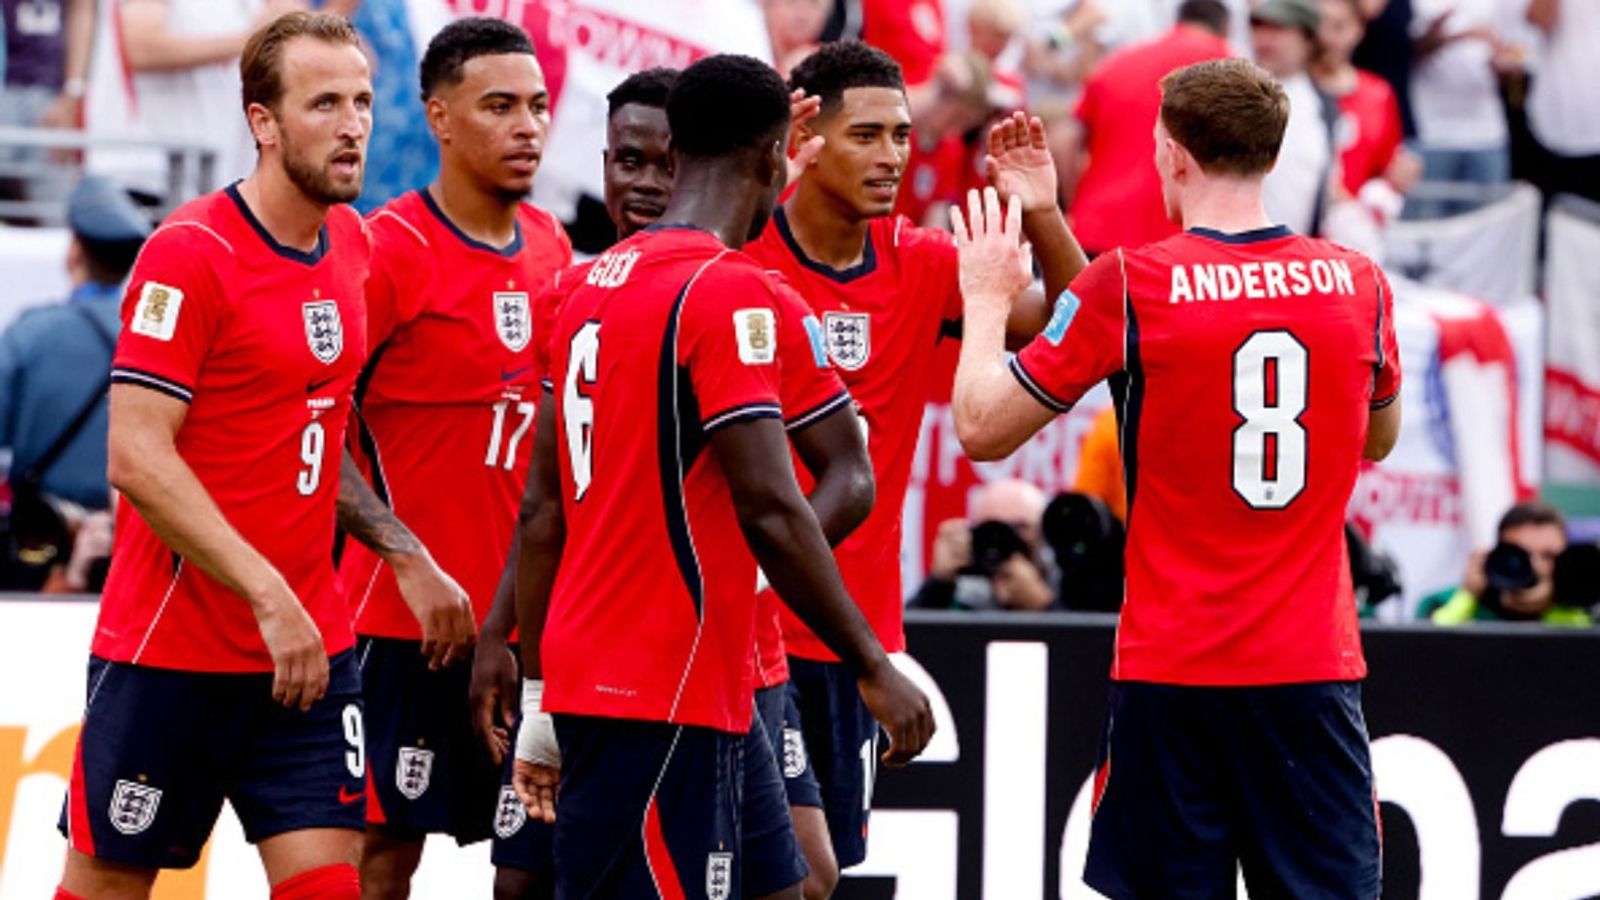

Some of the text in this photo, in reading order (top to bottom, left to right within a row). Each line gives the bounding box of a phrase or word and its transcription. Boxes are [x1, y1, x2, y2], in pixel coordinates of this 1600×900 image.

[1169, 259, 1355, 304] ANDERSON
[485, 401, 535, 471] 17
[563, 320, 602, 503] 6
[1231, 328, 1310, 510] 8
[297, 421, 325, 496] 9
[342, 704, 365, 778] 9
